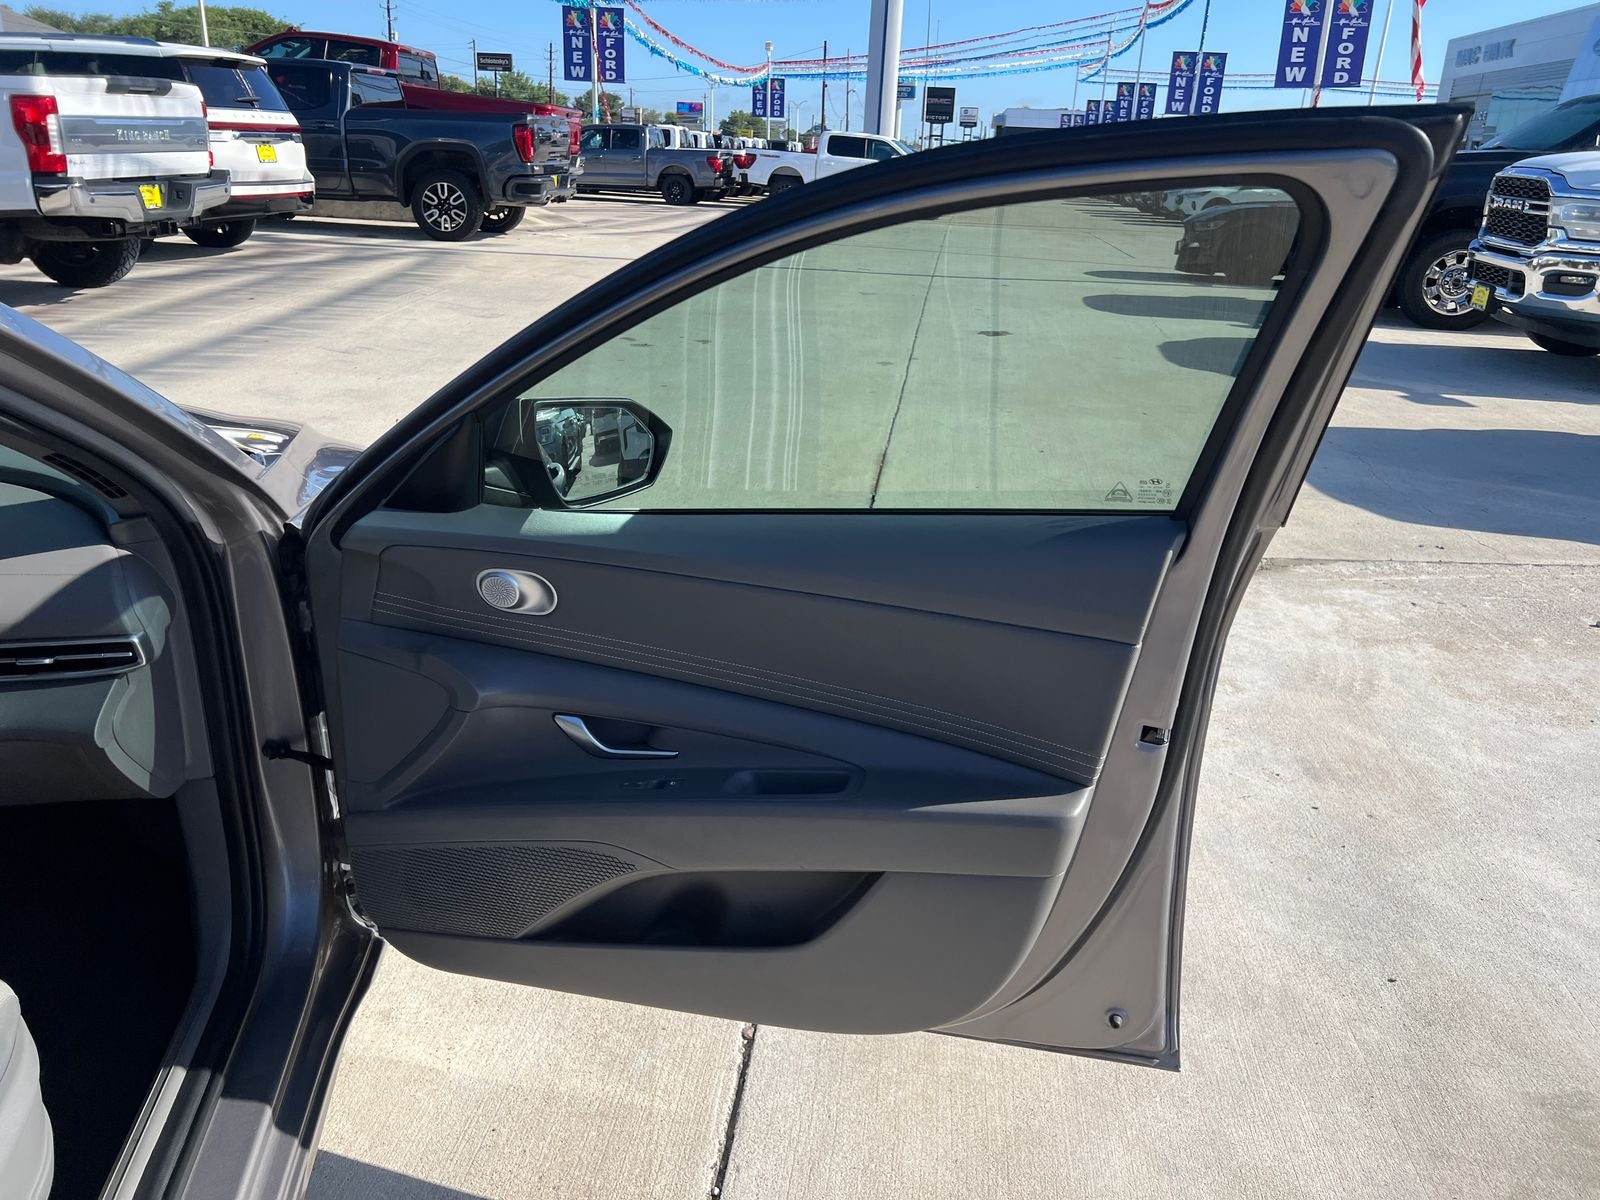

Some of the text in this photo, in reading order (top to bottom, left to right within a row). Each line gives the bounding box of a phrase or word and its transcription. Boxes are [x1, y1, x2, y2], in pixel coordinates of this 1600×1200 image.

[571, 36, 585, 78] NEW
[604, 38, 617, 80] FORD
[1285, 27, 1309, 82] NEW
[1333, 27, 1357, 84] FORD
[755, 93, 764, 116] NEW
[773, 93, 781, 116] FORD
[1139, 101, 1149, 120] FOR
[1171, 77, 1186, 112] NEW
[1201, 77, 1216, 113] FORD
[116, 129, 140, 141] KING
[1493, 196, 1523, 210] RAM
